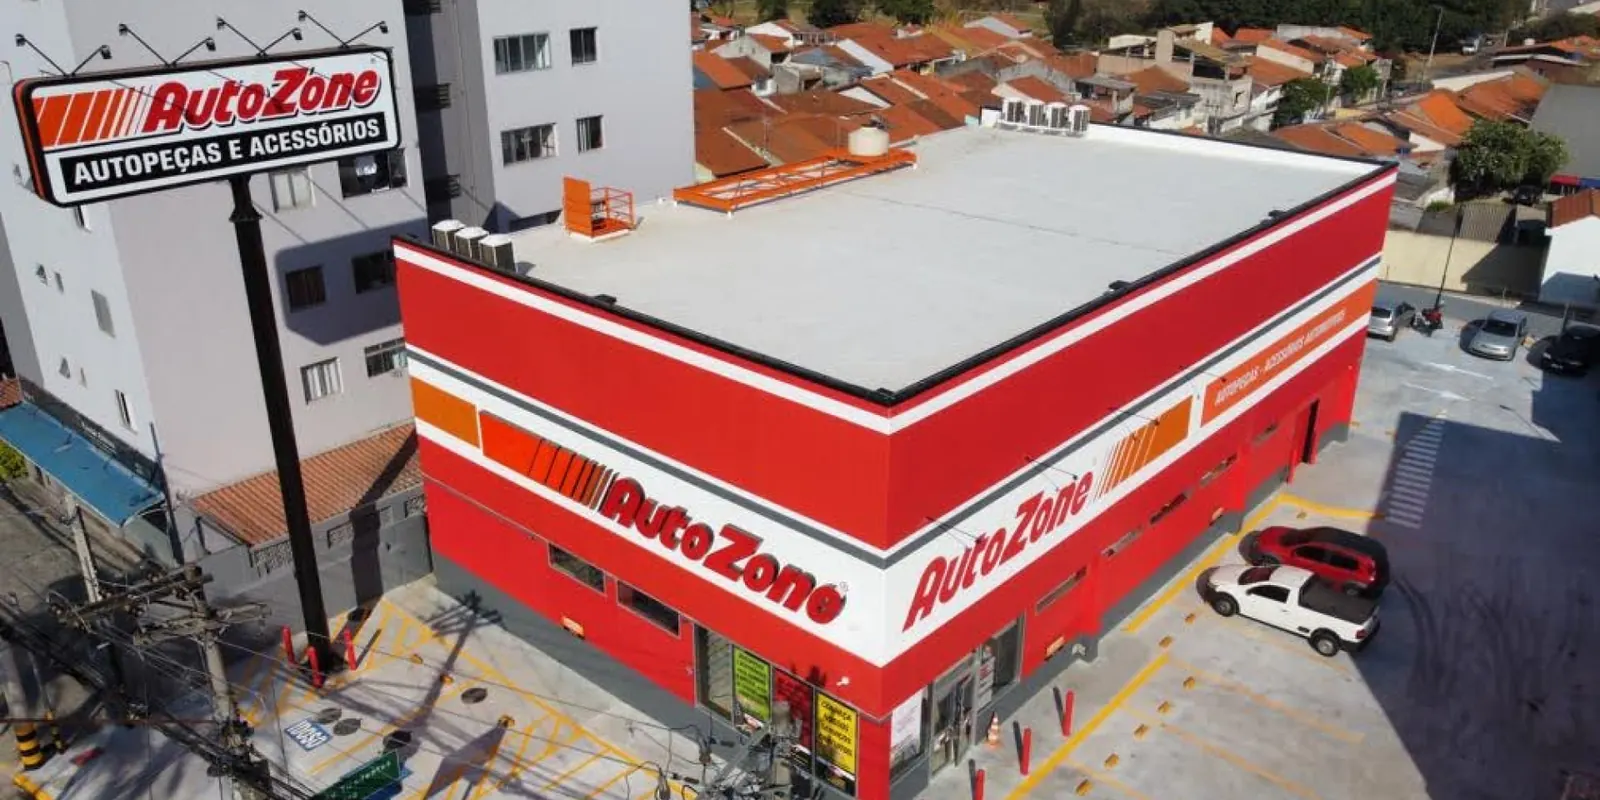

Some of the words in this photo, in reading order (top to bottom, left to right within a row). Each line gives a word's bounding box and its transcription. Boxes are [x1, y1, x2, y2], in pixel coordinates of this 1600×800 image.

[74, 139, 222, 186] AUTOPEÇAS
[229, 137, 243, 160] E
[250, 118, 381, 157] ACESSÓRIOS
[142, 67, 382, 134] AutoZone
[598, 477, 847, 624] AutoZone
[902, 471, 1093, 633] AutoZone
